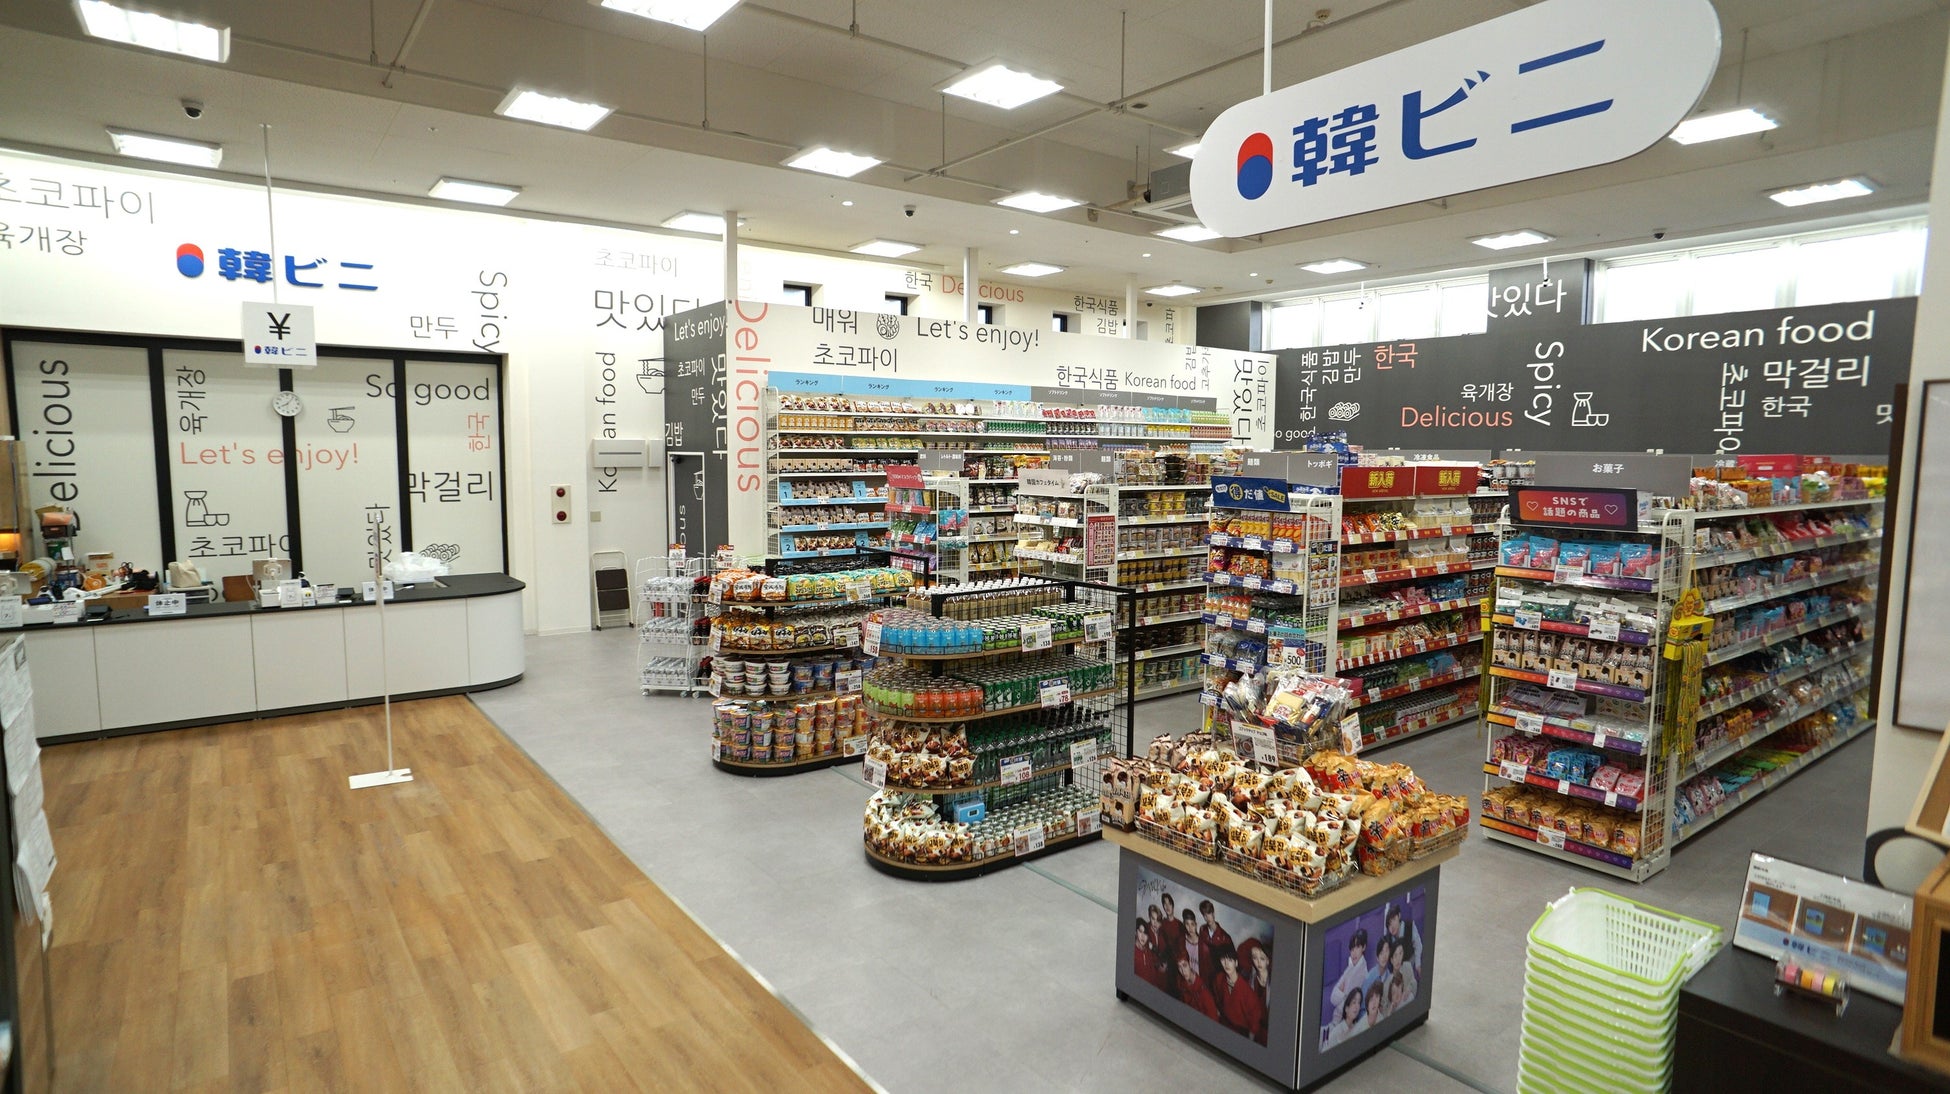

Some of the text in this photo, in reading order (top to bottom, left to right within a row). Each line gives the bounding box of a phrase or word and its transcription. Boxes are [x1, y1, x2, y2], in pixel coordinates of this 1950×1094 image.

[1291, 38, 1614, 188] 韓ビニ
[217, 247, 378, 291] 韓ビニ
[594, 249, 678, 278] 초코파이
[904, 270, 933, 292] 한국
[941, 275, 1025, 303] Decious
[471, 270, 508, 353] Spicy
[1073, 295, 1119, 318] 한국식품
[410, 315, 459, 340] 만두
[674, 322, 696, 342] Let's
[917, 316, 1040, 354] Let's enjoy!
[1096, 317, 1119, 337] 김밥
[1641, 309, 1876, 353] Korean food
[677, 358, 706, 380] 초코파이
[813, 343, 898, 373] 초코파이
[1322, 349, 1340, 385] 김밥
[1343, 347, 1362, 384] 만두
[1373, 343, 1419, 371] 한국
[595, 352, 617, 405] food
[1056, 365, 1197, 392] 한국식품 Korean food
[1299, 350, 1318, 422] 한국식품
[1523, 341, 1565, 427] Spicy
[1762, 355, 1872, 390] 막걸리
[176, 366, 208, 435] 육개장
[414, 377, 490, 405] good
[691, 386, 706, 407] 만두
[1232, 359, 1254, 446] 맛있다
[1460, 382, 1515, 403] 육개장
[1400, 404, 1514, 428] Delicious
[1761, 395, 1813, 418] 한국
[665, 422, 684, 447] 김밥
[180, 442, 256, 466] Let's
[1307, 460, 1333, 469] トッポギ
[1592, 463, 1625, 474] お菓子
[408, 471, 493, 503] 막걸리
[1552, 496, 1589, 506] SNSで
[1543, 507, 1600, 519] 話題の商品
